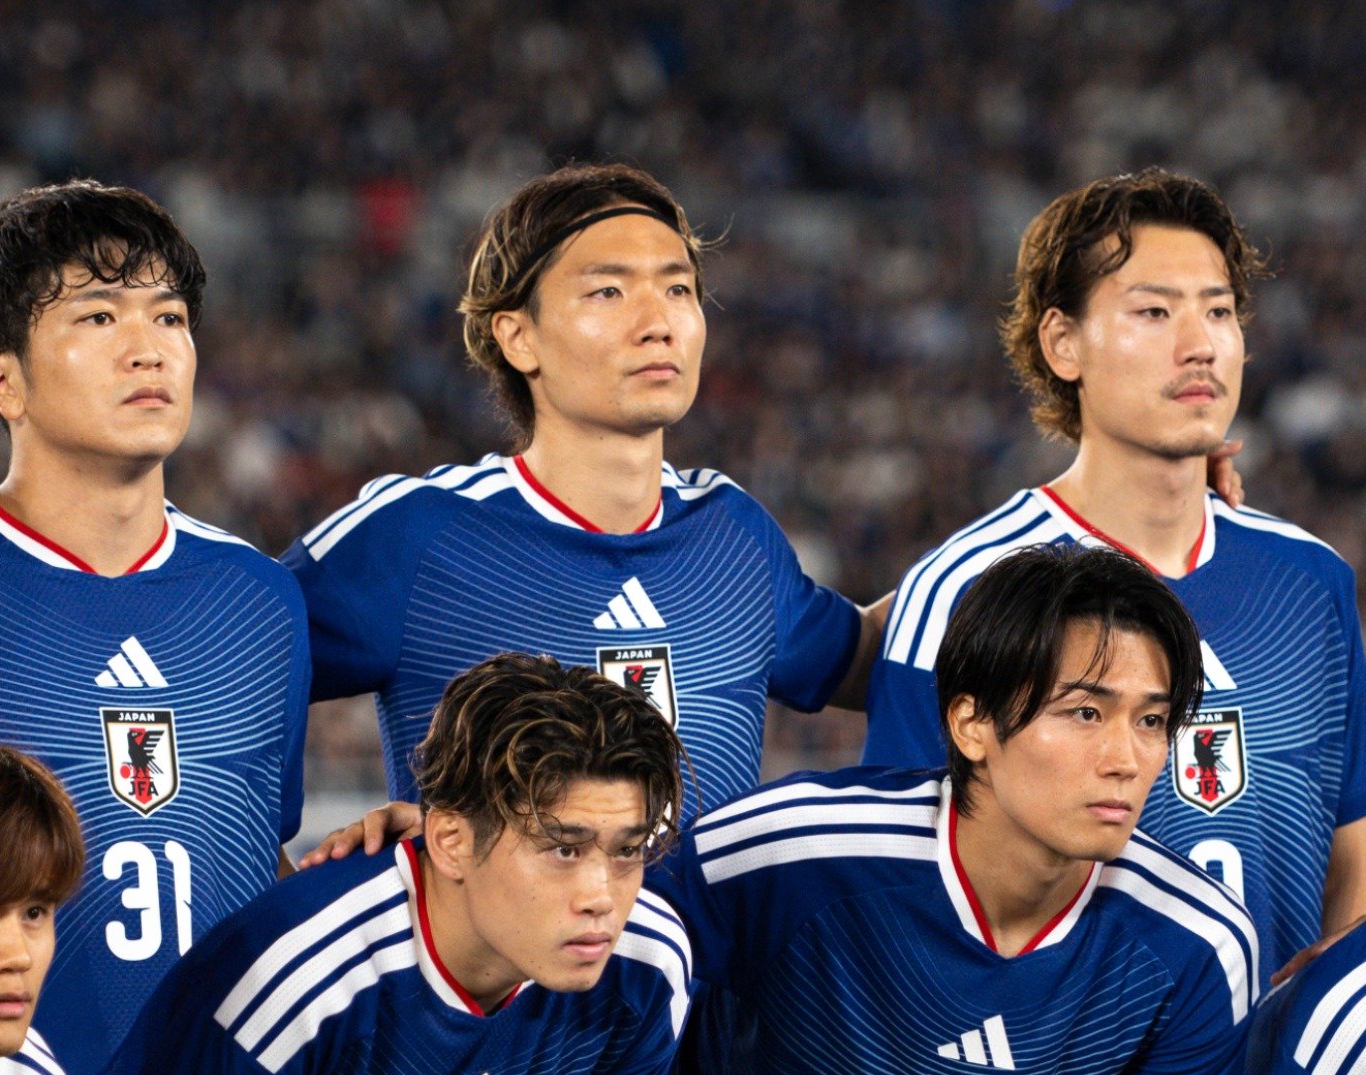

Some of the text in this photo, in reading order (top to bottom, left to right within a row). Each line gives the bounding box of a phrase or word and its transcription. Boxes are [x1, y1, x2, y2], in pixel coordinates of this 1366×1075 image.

[615, 649, 653, 660] JAPAN
[118, 712, 156, 722] JAPAN
[127, 780, 159, 797] JFA
[102, 841, 193, 962] 31
